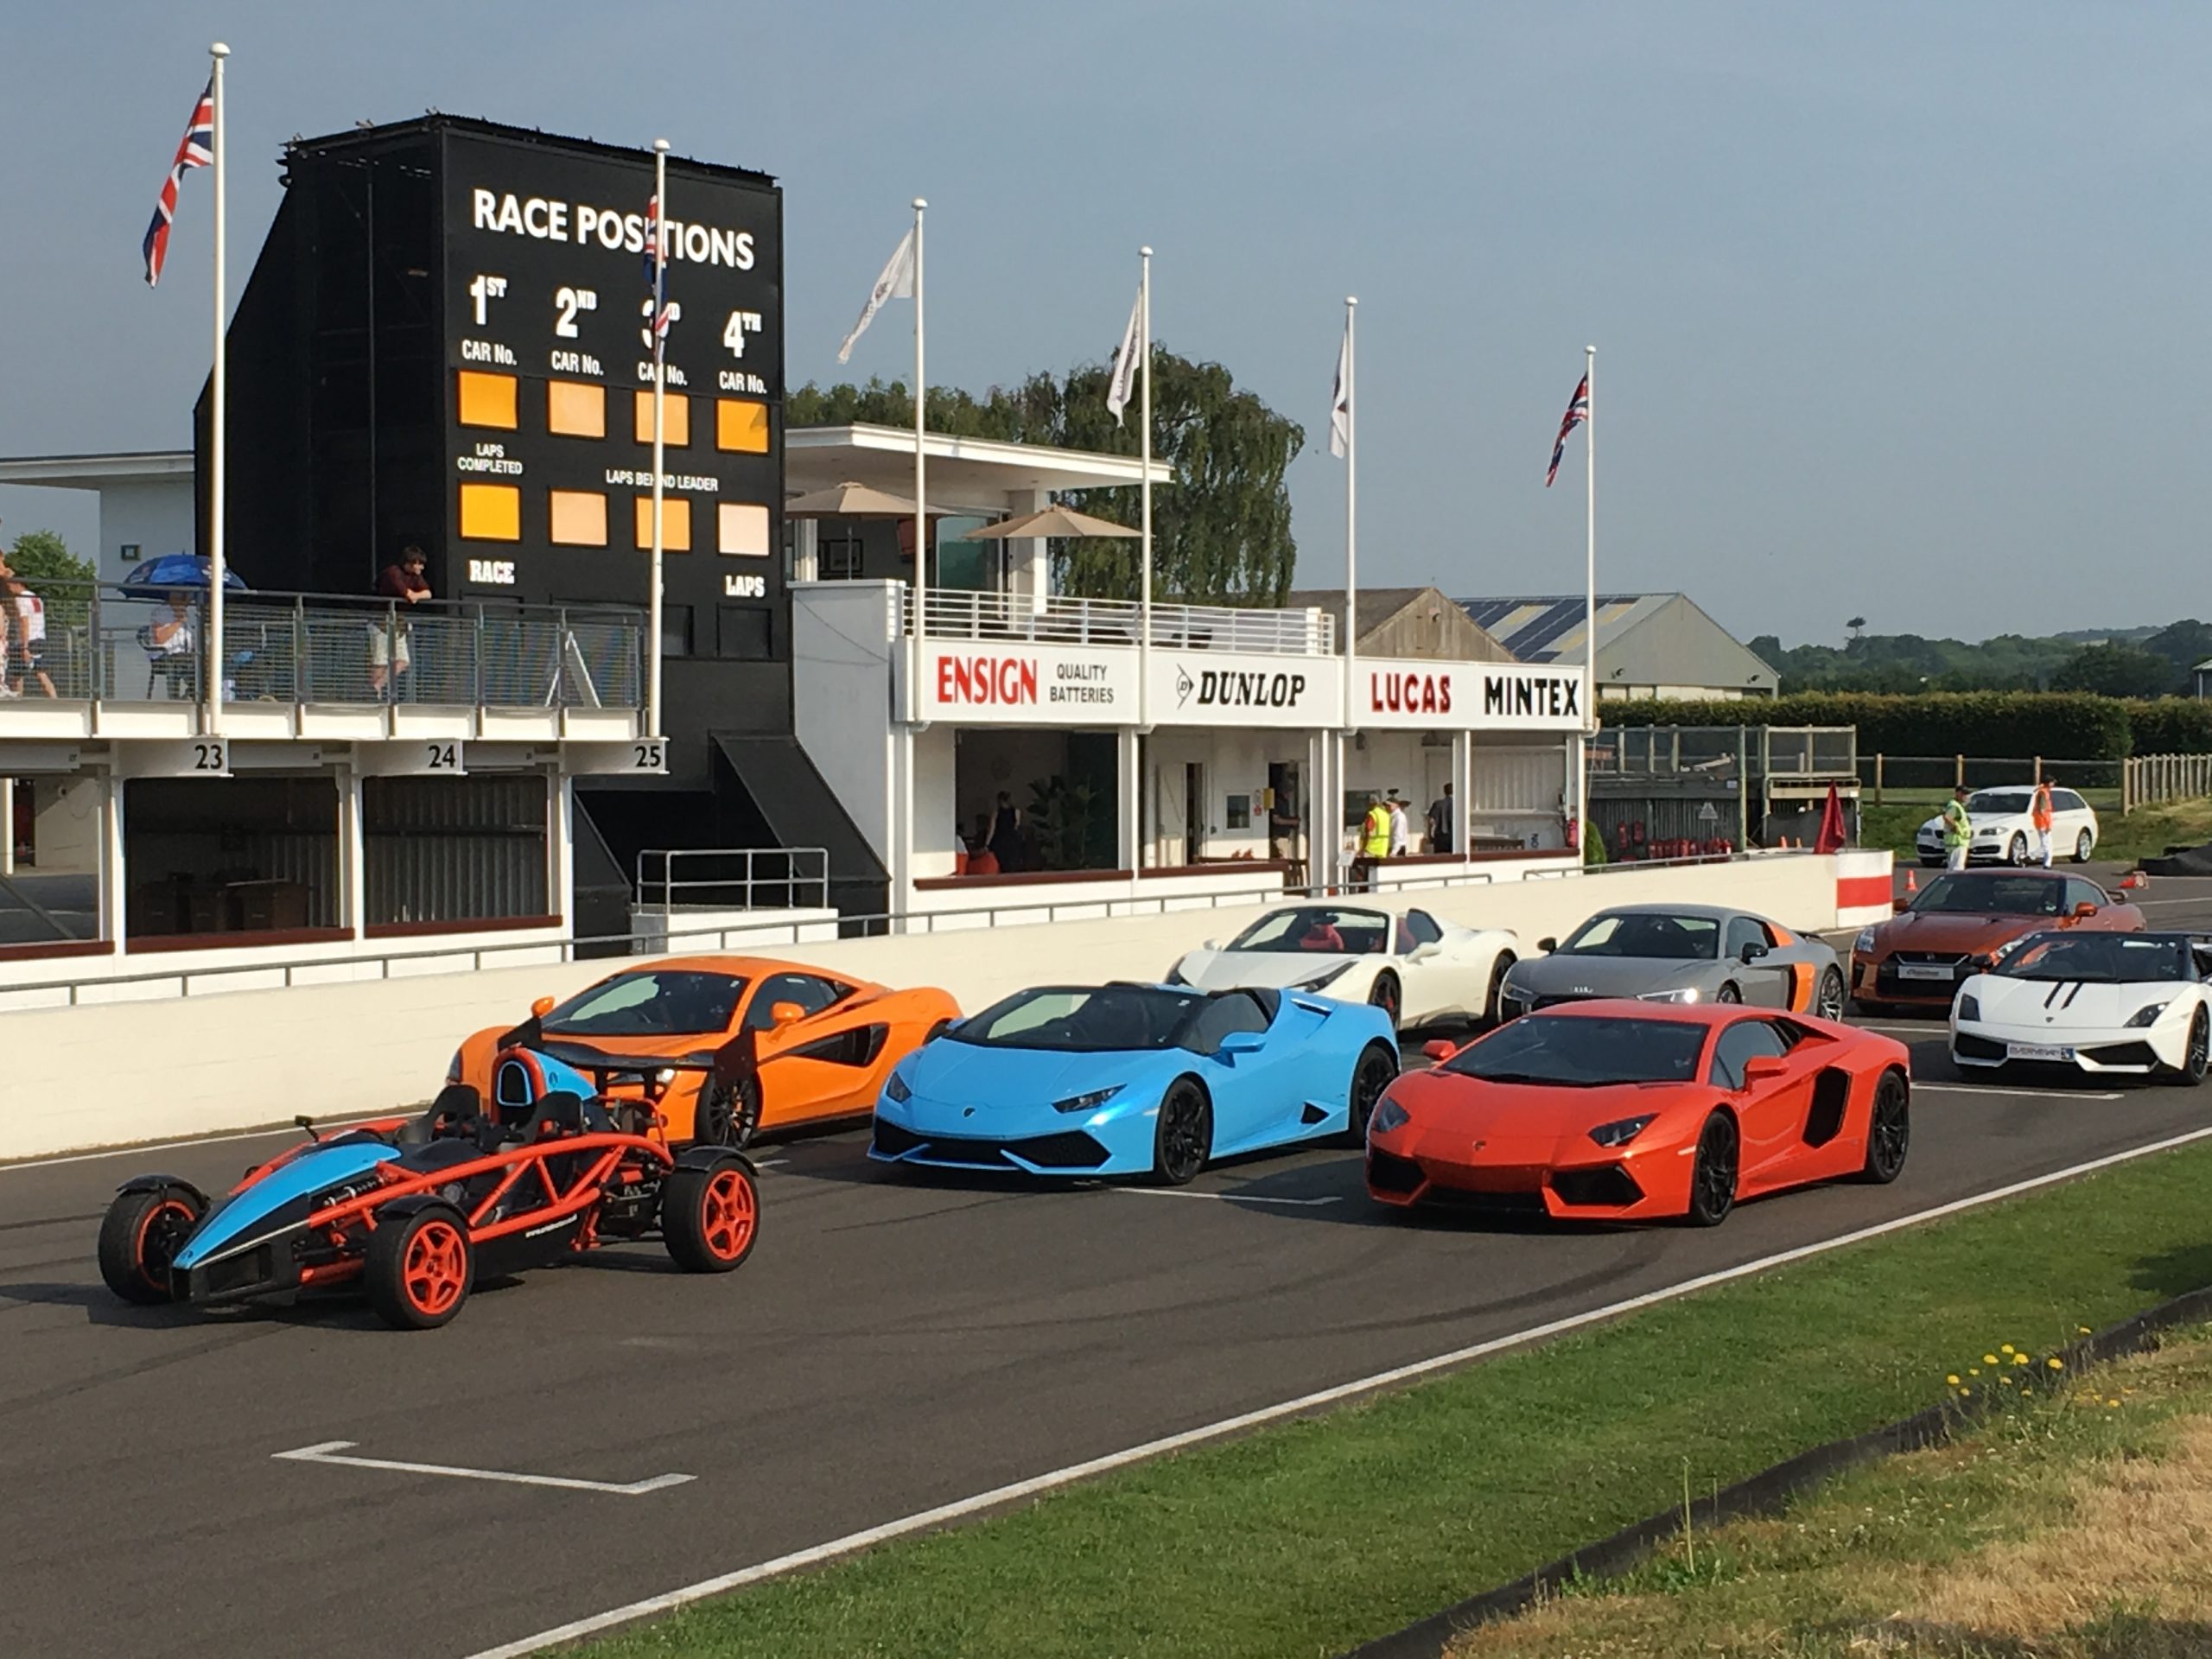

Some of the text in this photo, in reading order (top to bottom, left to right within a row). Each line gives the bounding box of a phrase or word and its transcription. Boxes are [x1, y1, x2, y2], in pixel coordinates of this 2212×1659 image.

[474, 188, 568, 241] RACE
[470, 275, 507, 325] 1ST
[556, 287, 597, 338] 2ND
[642, 299, 681, 349] 3D
[723, 311, 762, 358] 4TH
[461, 340, 518, 366] CAR No.
[551, 350, 604, 377] CAR No.
[638, 361, 688, 385] CA No.
[719, 371, 767, 395] CAR No.
[476, 442, 504, 458] LAPS
[457, 457, 523, 475] COMPLETED
[606, 469, 719, 492] LAPS BEHND LEADER
[469, 559, 515, 584] RACE
[725, 575, 765, 598] LAPS
[938, 656, 1037, 705] ENSIGN
[1057, 664, 1107, 681] QUALITY
[1050, 686, 1114, 704] BATTERIES
[1197, 671, 1306, 707] DUNLOP
[1370, 672, 1451, 714] LUCAS
[1484, 676, 1579, 716] MINTEX
[194, 745, 223, 770] 23
[428, 744, 455, 768] 24
[634, 745, 661, 768] 25
